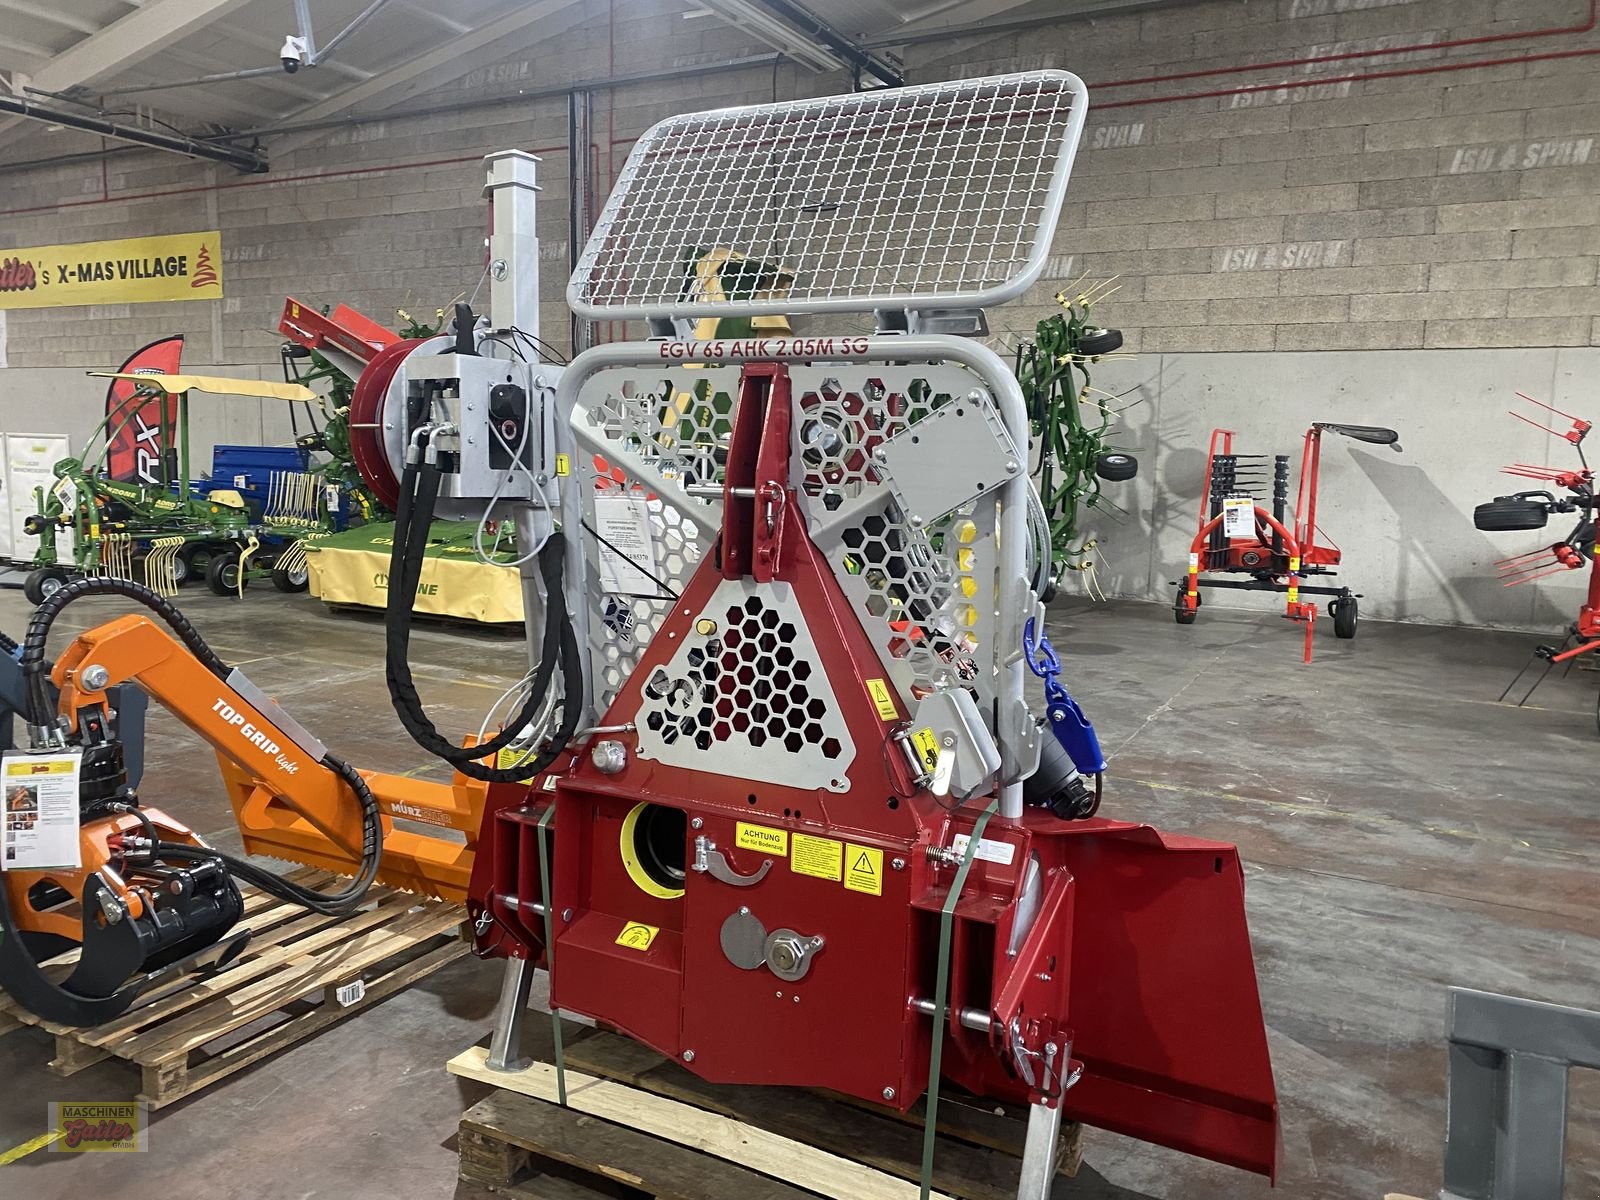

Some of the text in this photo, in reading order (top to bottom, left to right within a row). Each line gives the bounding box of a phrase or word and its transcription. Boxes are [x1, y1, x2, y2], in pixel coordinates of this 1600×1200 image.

[1091, 123, 1145, 148] SPAN
[58, 260, 114, 284] X-MAS
[117, 255, 188, 279] VILLAGE
[660, 337, 869, 359] EGV 65 AHK 2.05M SG
[212, 698, 299, 775] TOP GRIP light
[744, 829, 780, 843] ACHTUNG
[758, 841, 784, 851] Bodenzug
